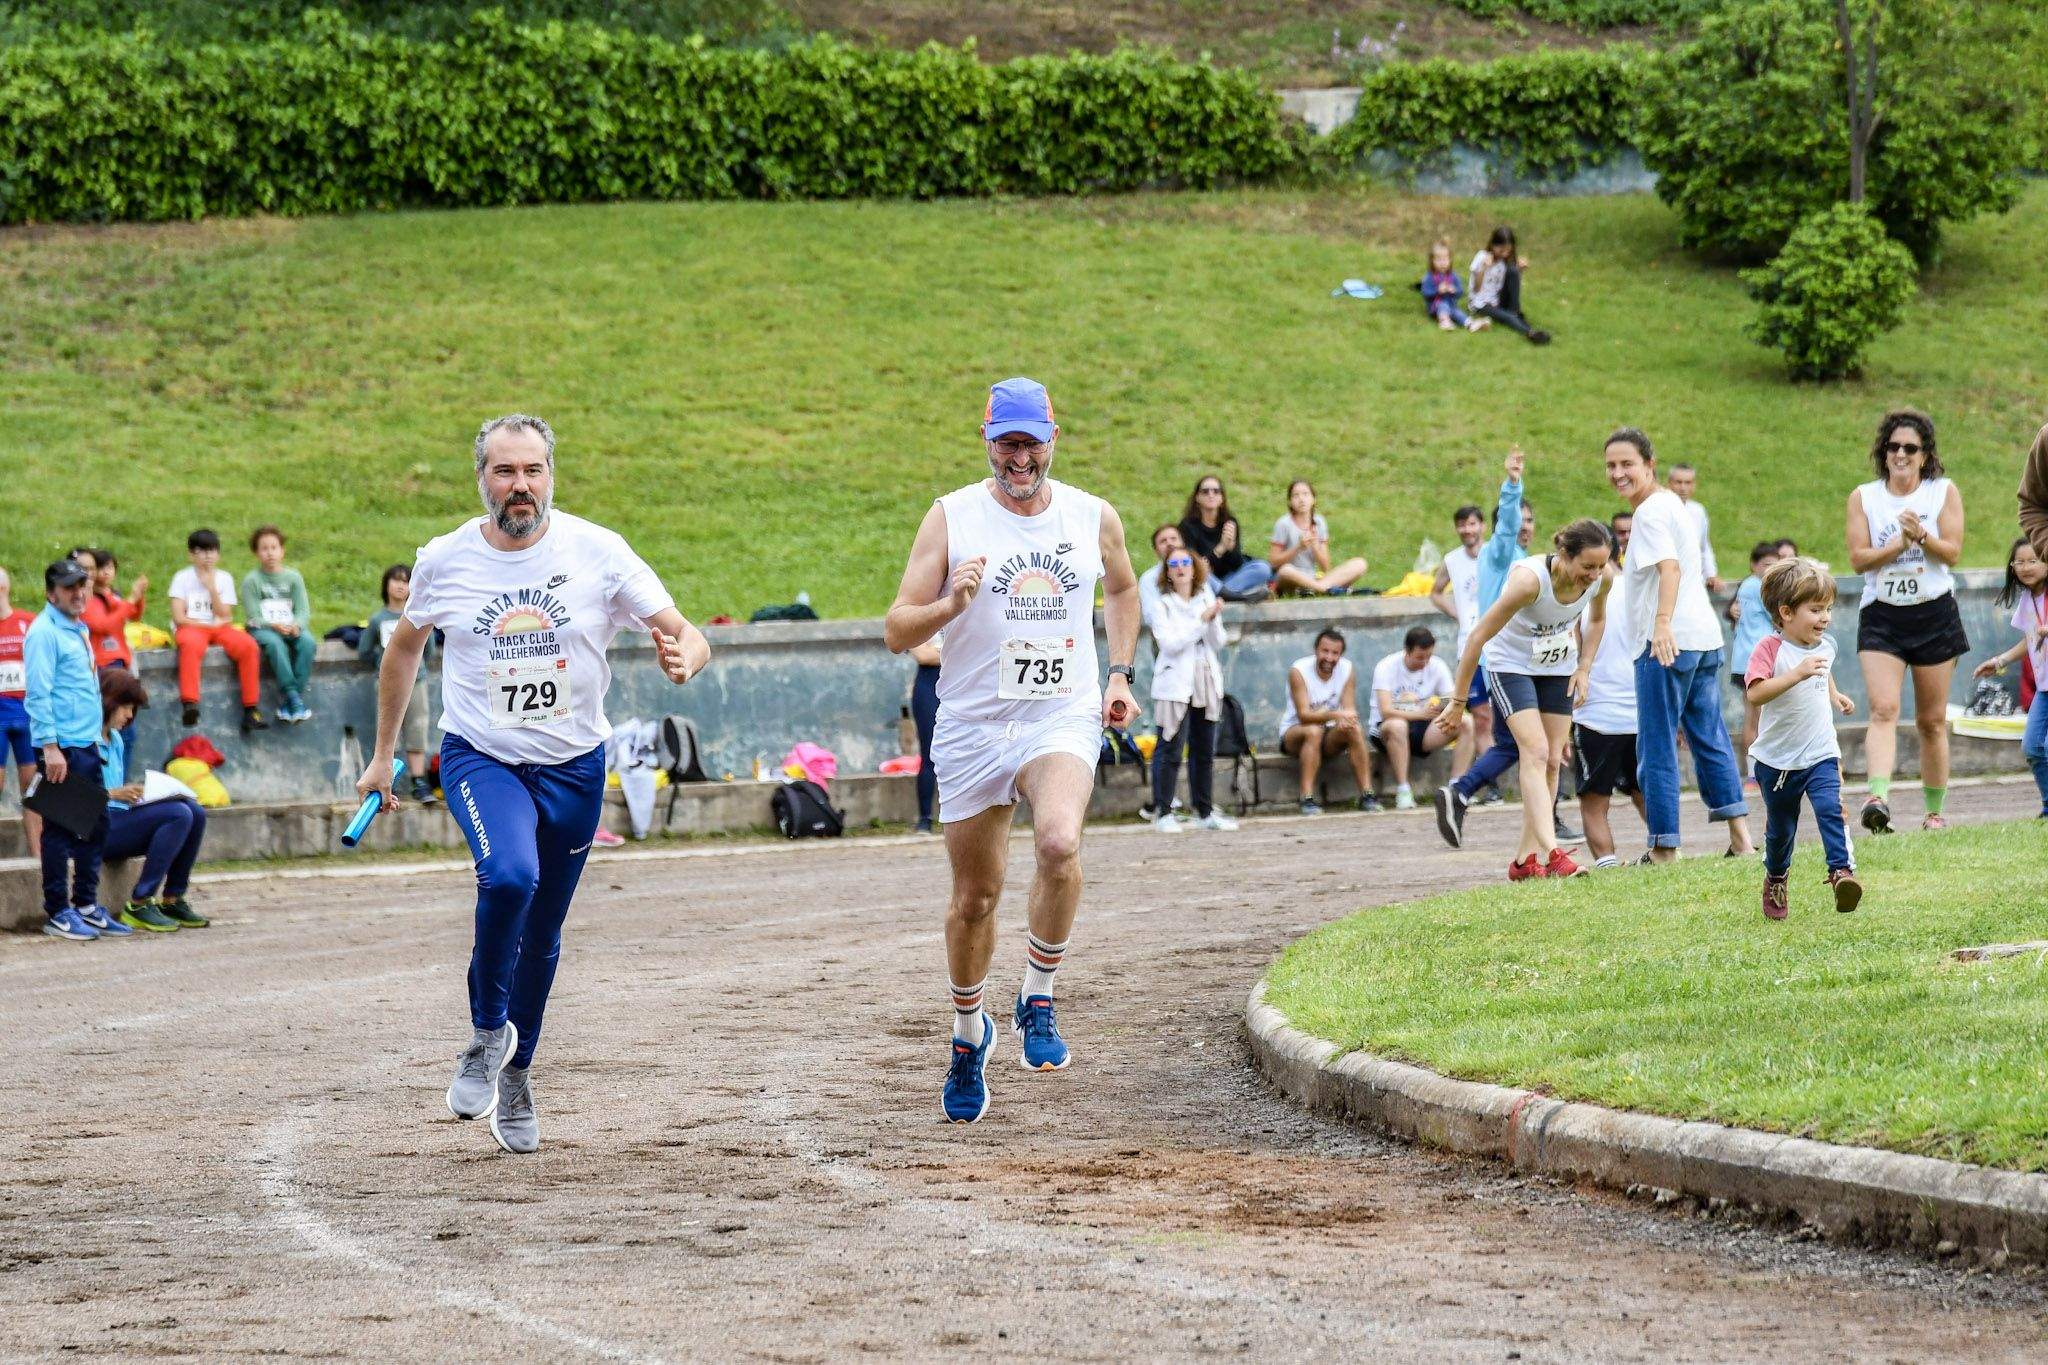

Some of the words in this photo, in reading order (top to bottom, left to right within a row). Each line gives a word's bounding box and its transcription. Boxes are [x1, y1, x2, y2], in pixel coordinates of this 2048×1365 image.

[1058, 542, 1073, 550] NIKE
[550, 575, 568, 583] NIKE
[991, 554, 1027, 595] SANTA
[1030, 552, 1080, 594] MONICA
[1884, 579, 1918, 597] 749
[1008, 596, 1038, 608] TRACK
[1041, 596, 1064, 608] CLUB
[472, 593, 515, 636] SANTA
[518, 588, 571, 628] MONICA
[1004, 609, 1067, 621] VALLEHERMOSO
[492, 634, 525, 648] TRACK
[529, 631, 555, 645] CLUB
[489, 644, 560, 661] VALLEHERMOSO
[1540, 645, 1568, 664] 751
[1014, 658, 1064, 685] 735
[501, 681, 557, 712] 729
[1057, 686, 1073, 694] 2023
[466, 796, 492, 859] MARATHON
